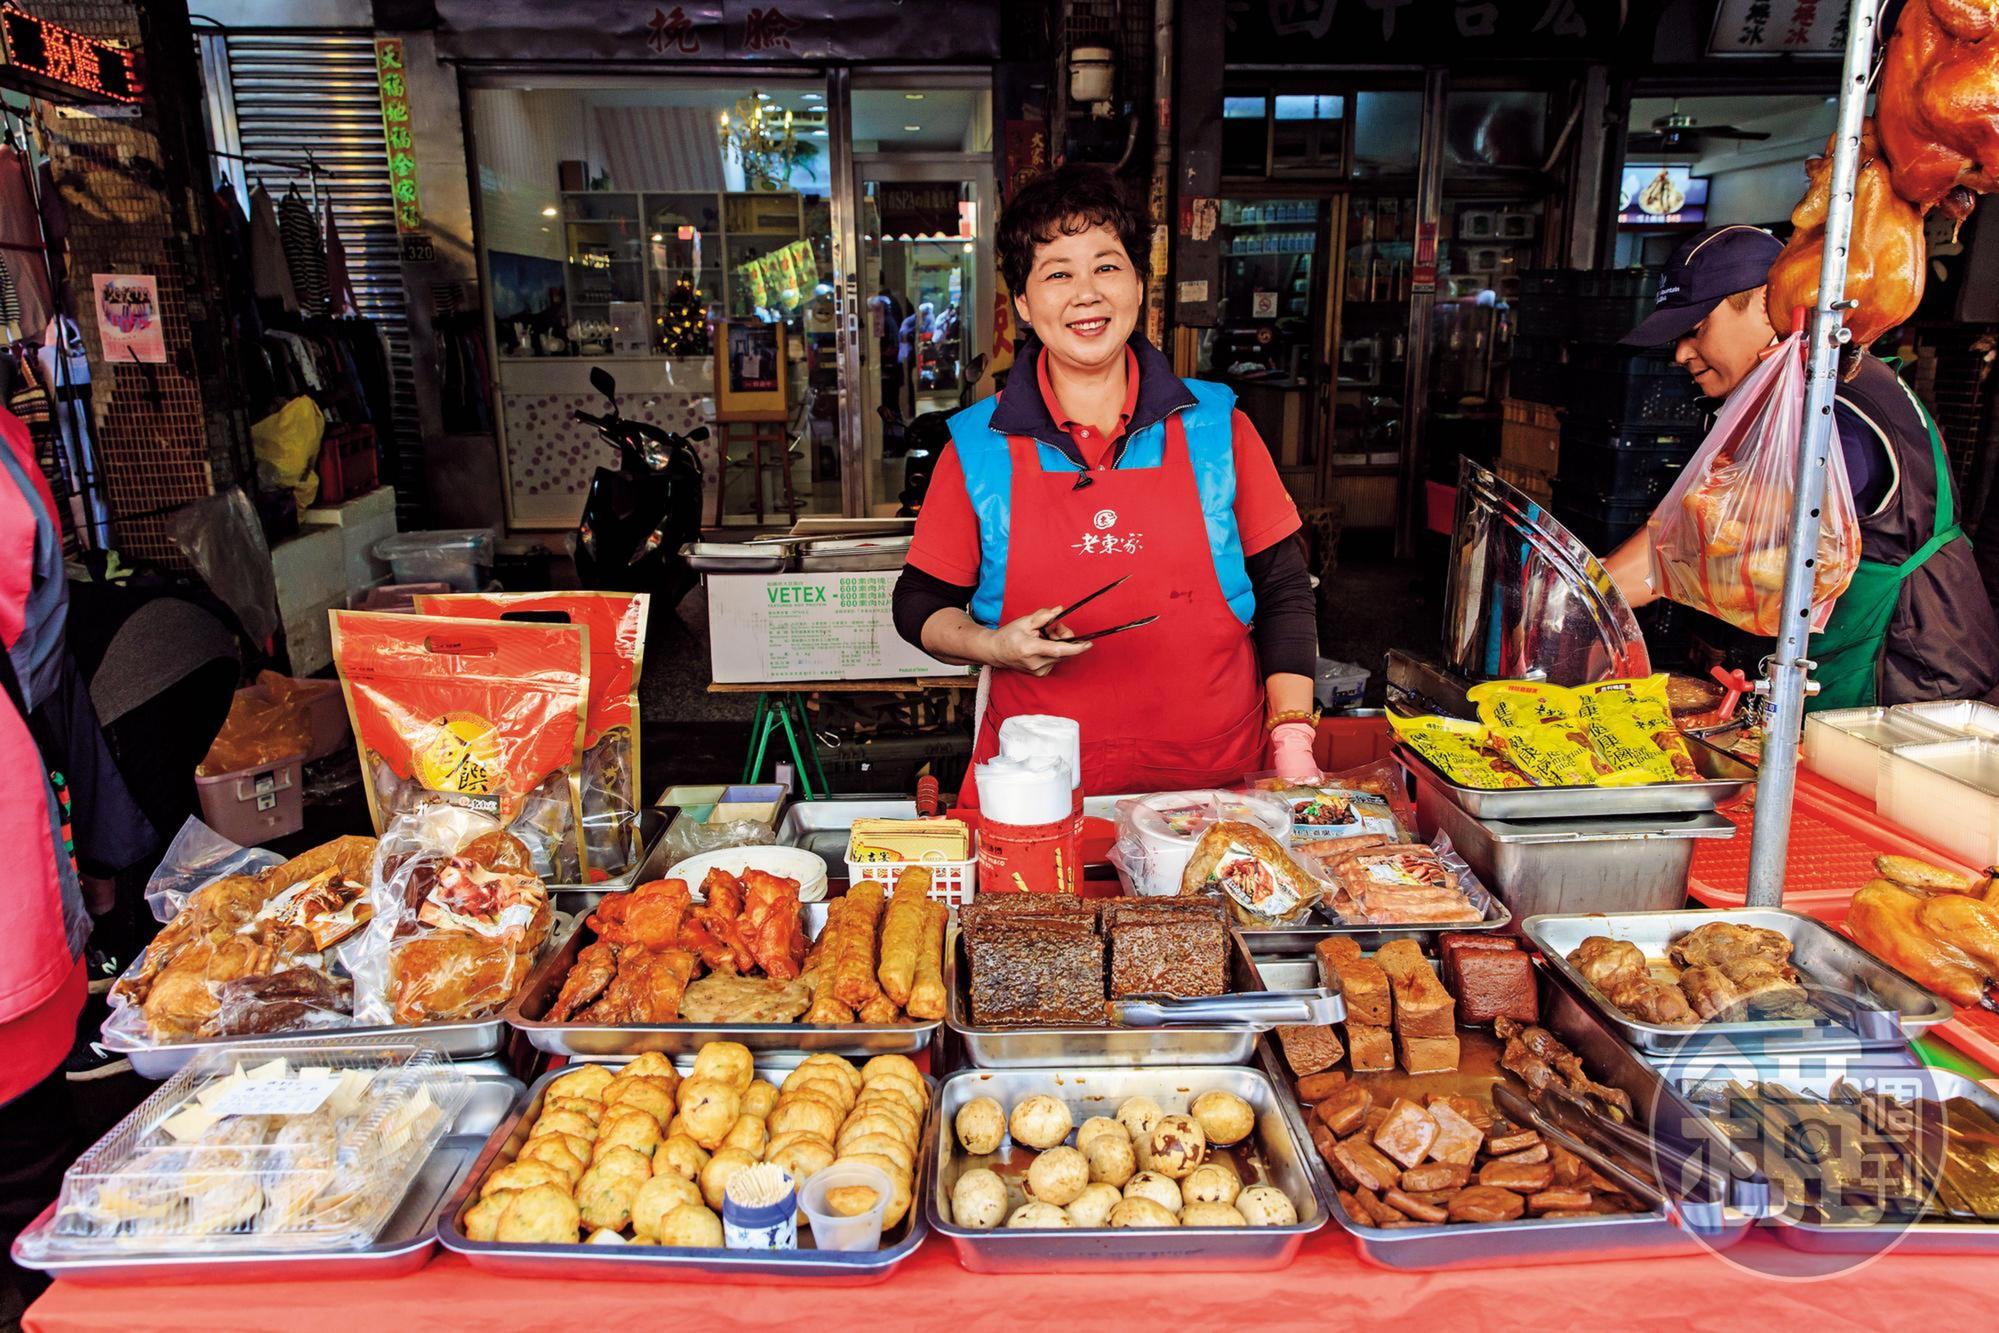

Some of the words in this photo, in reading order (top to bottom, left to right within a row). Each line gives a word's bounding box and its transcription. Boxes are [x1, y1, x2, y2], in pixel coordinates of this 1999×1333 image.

[408, 246, 433, 259] 320
[1071, 532, 1144, 556] 老東家
[767, 586, 827, 604] VETEX
